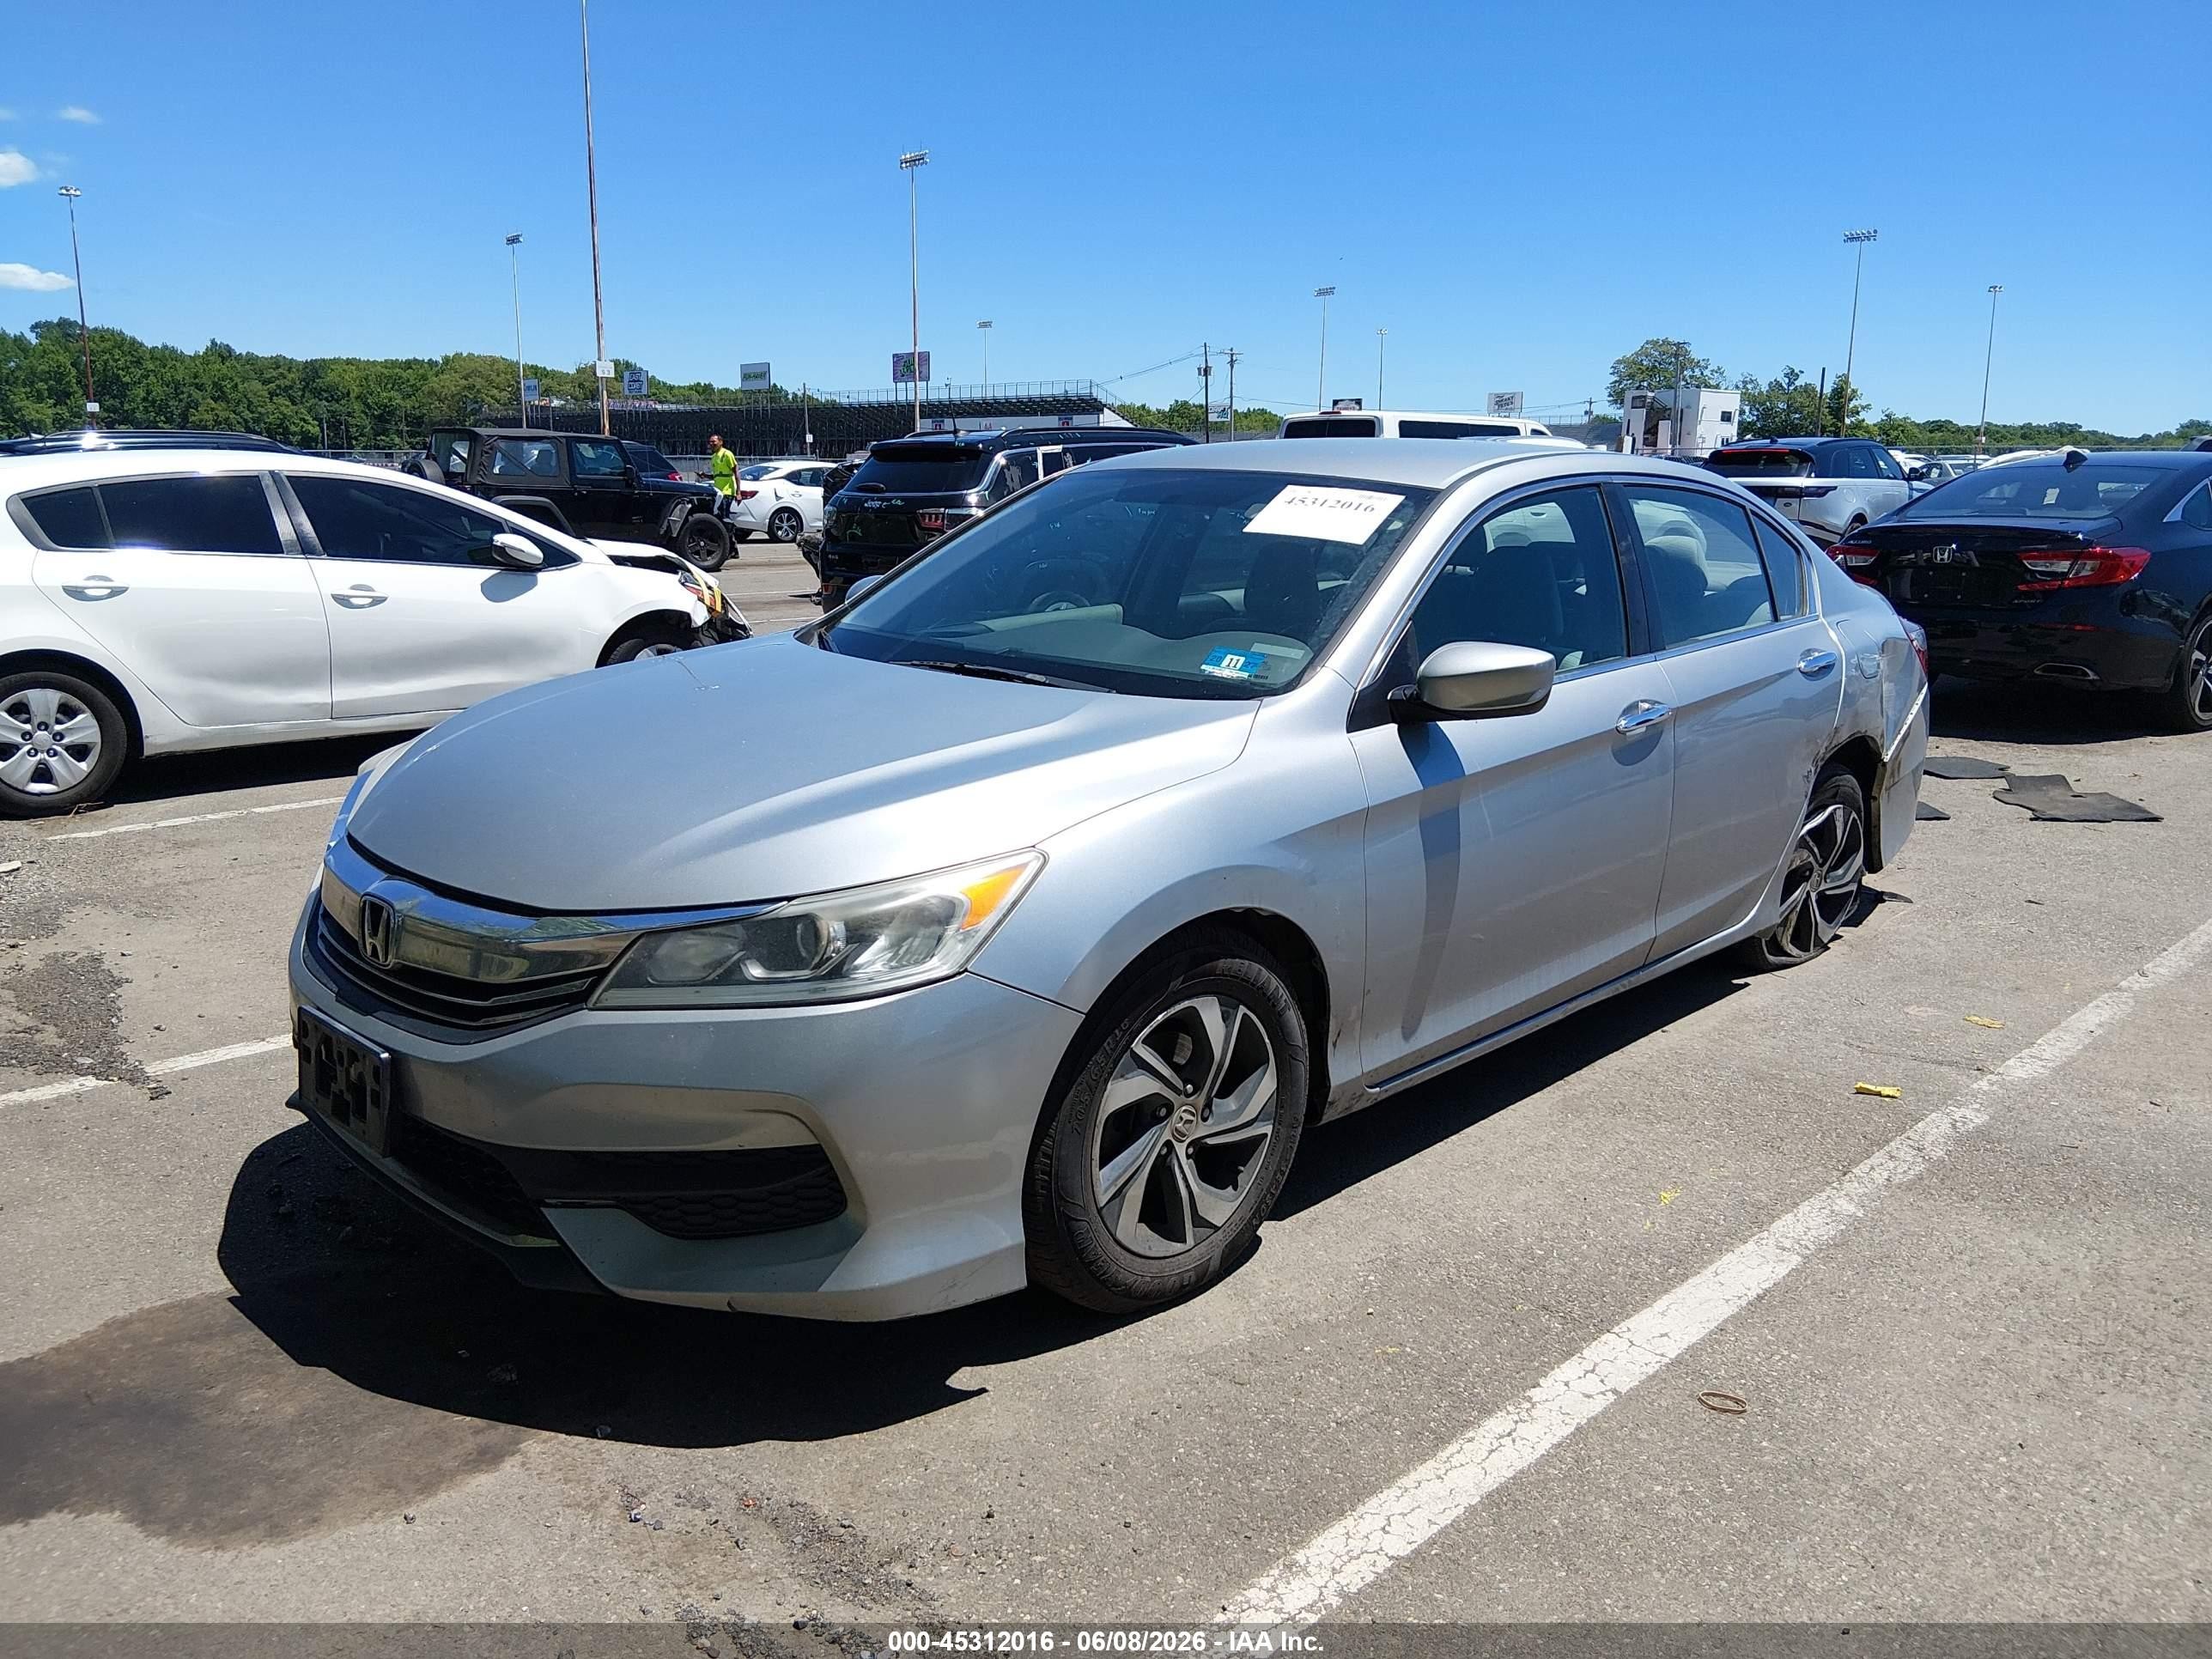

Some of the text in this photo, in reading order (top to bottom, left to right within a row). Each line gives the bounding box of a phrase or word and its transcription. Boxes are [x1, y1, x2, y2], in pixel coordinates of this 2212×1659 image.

[1285, 495, 1376, 514] 45312016
[1210, 654, 1224, 663] 20
[1225, 657, 1242, 668] 11
[1216, 961, 1291, 1018] RELIANT
